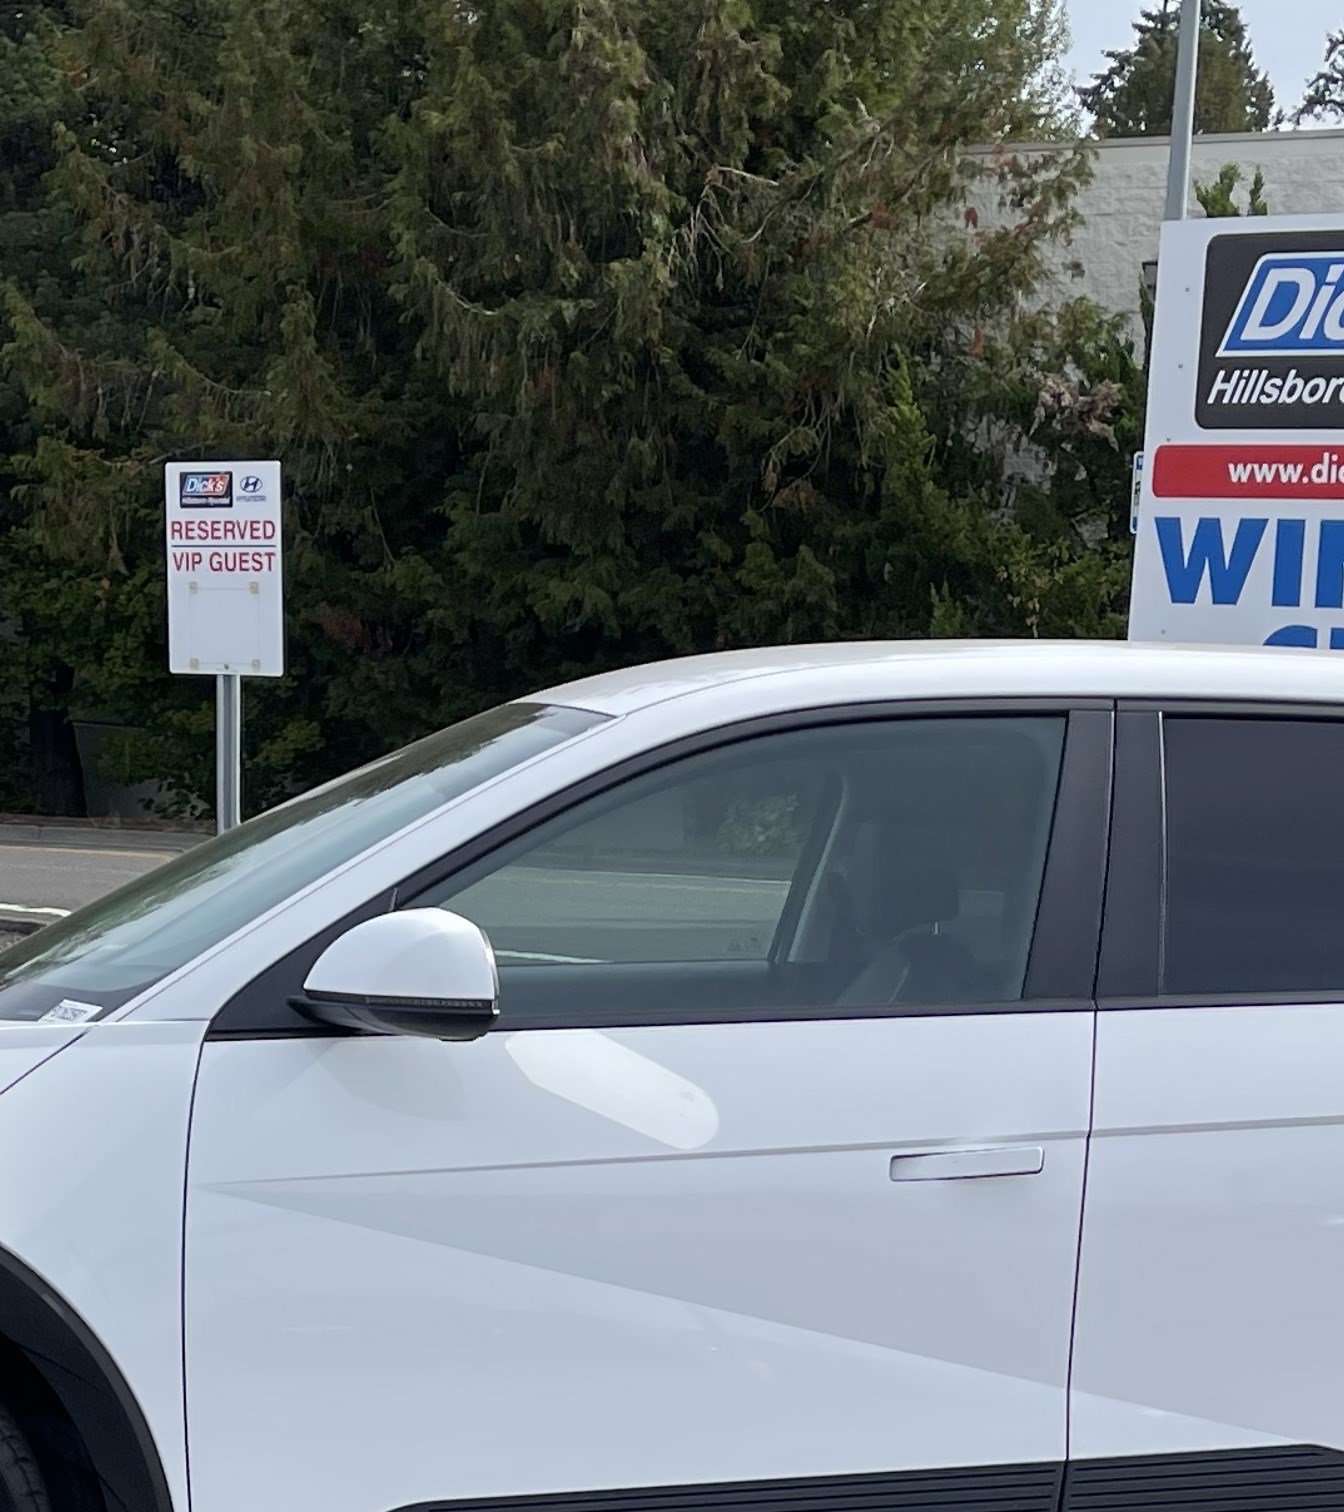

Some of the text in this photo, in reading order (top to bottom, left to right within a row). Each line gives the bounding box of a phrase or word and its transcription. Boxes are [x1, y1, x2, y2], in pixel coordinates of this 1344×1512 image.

[171, 520, 275, 540] RESERVED
[172, 552, 276, 572] VIP GUEST
